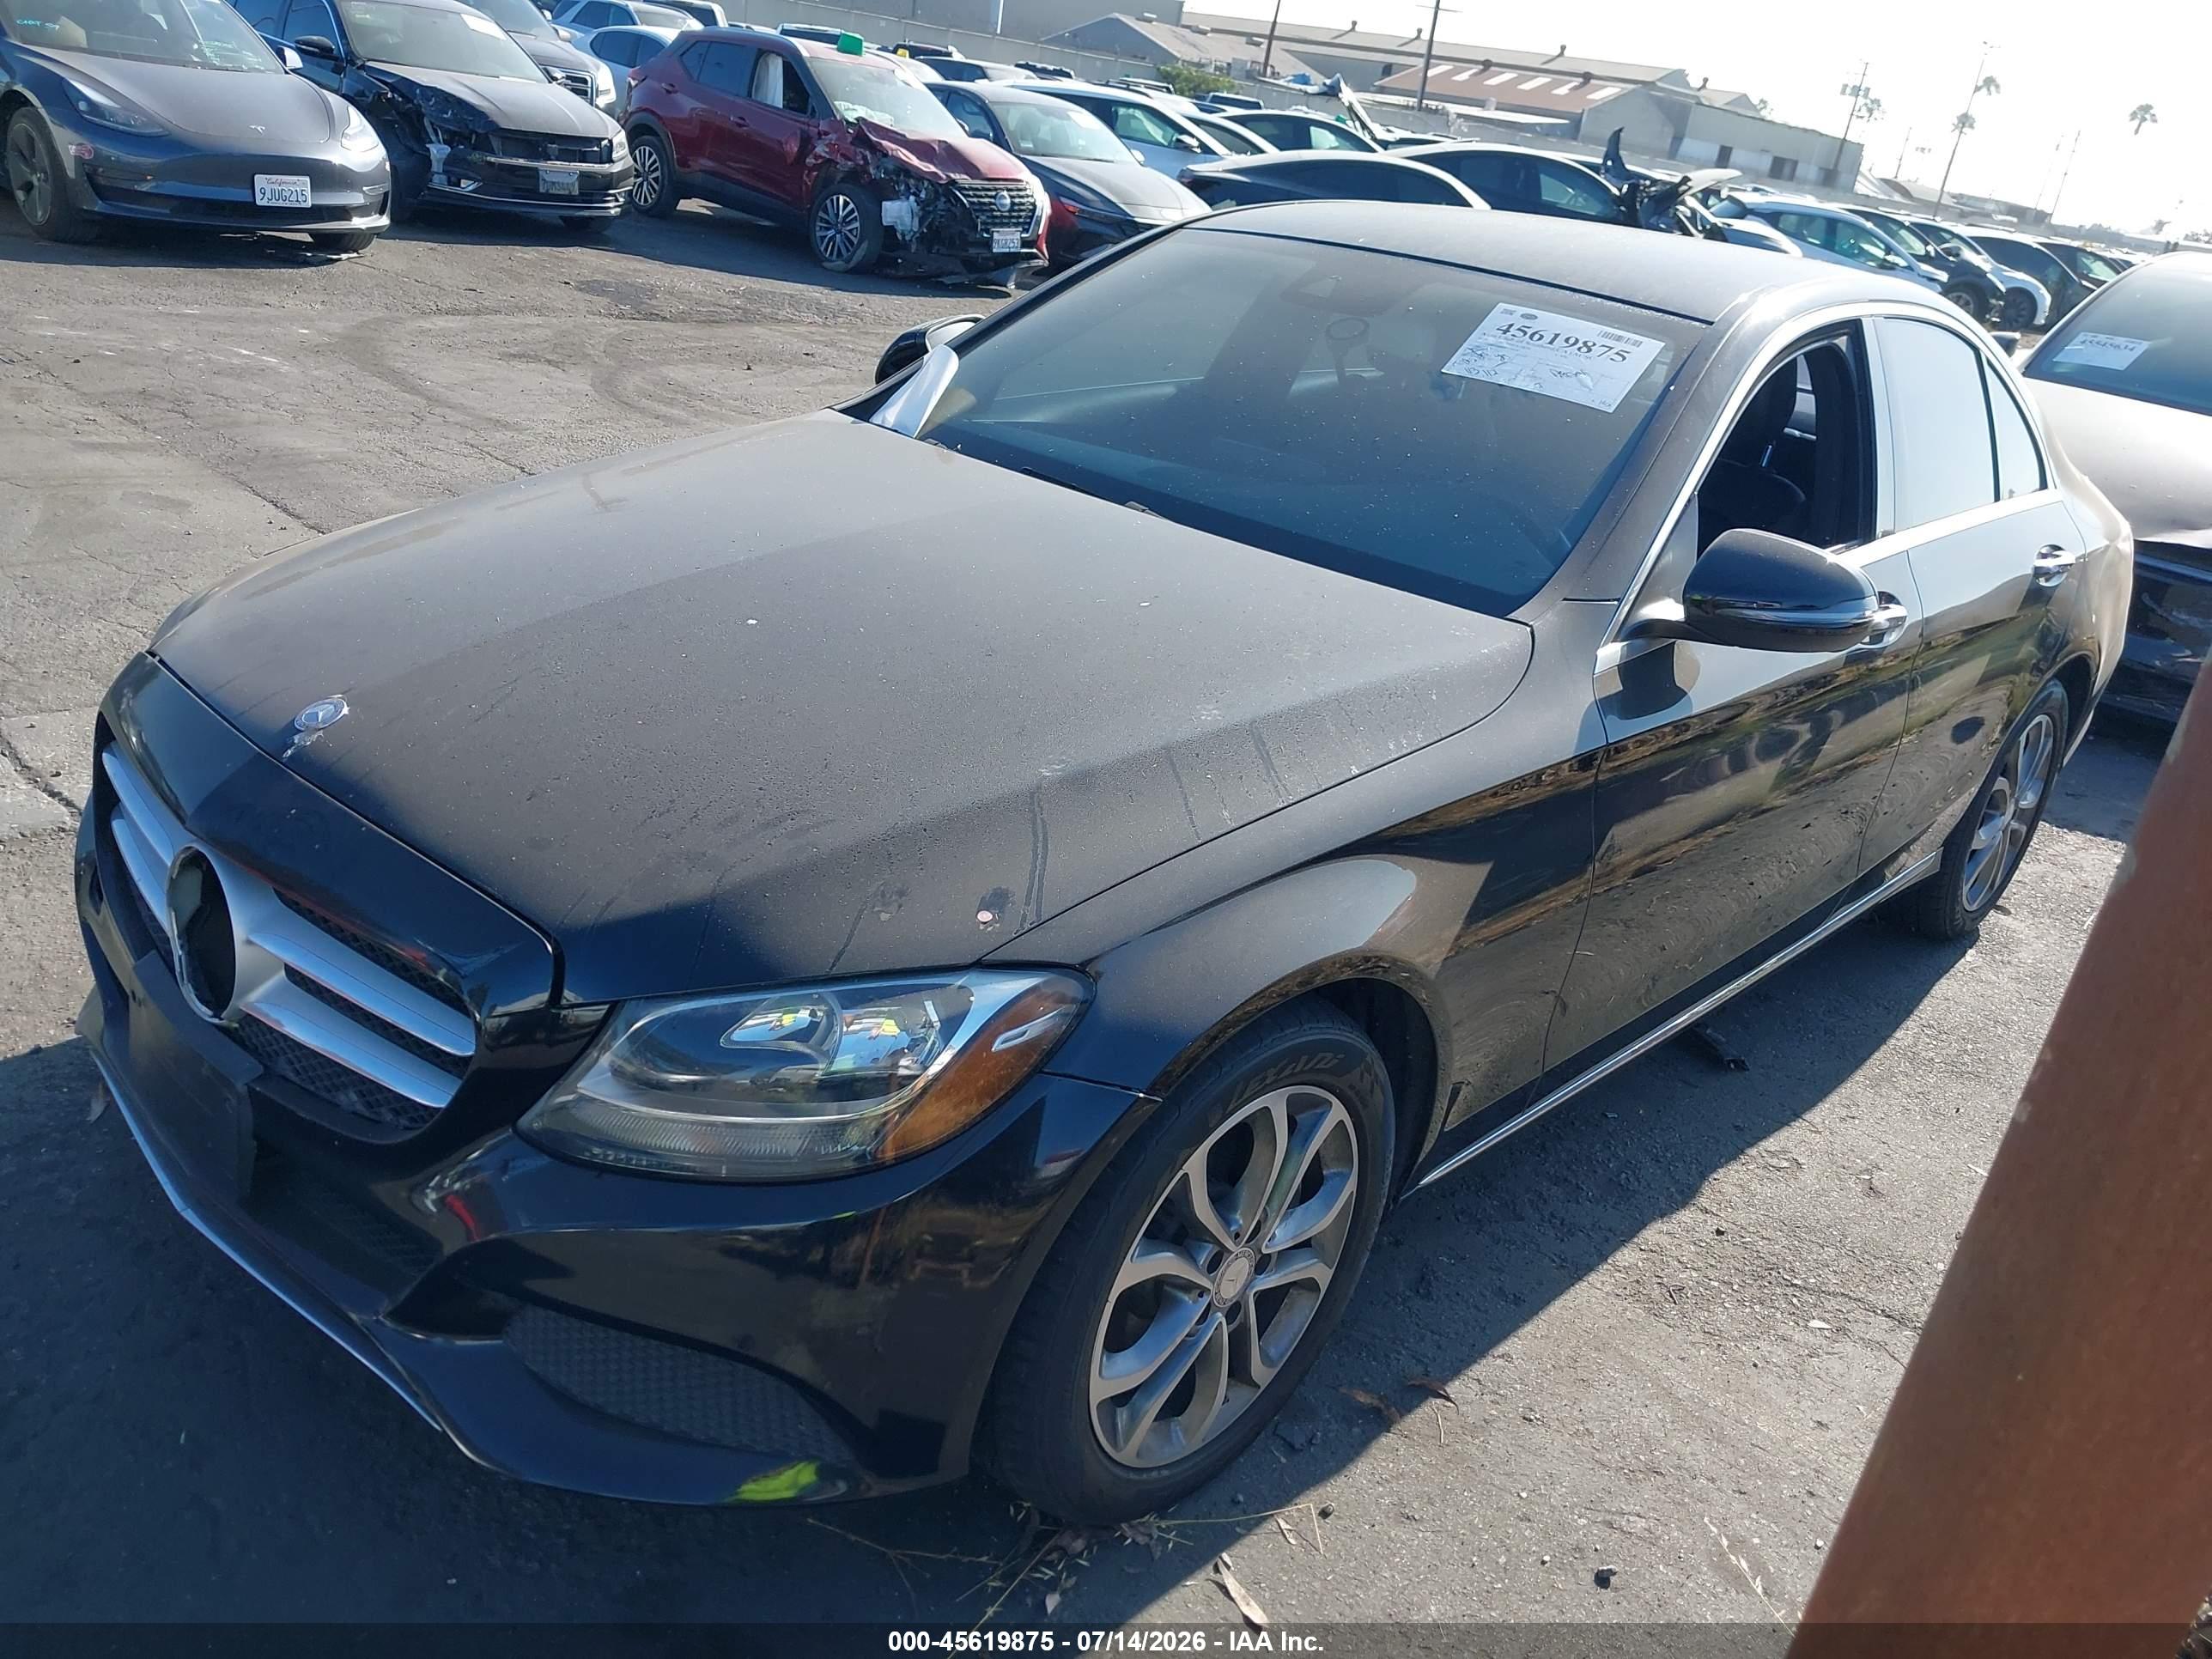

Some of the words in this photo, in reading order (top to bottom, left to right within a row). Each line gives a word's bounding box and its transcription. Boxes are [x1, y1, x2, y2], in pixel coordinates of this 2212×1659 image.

[266, 178, 298, 187] California
[259, 186, 307, 203] 9JUG215
[1496, 322, 1631, 363] 45619875
